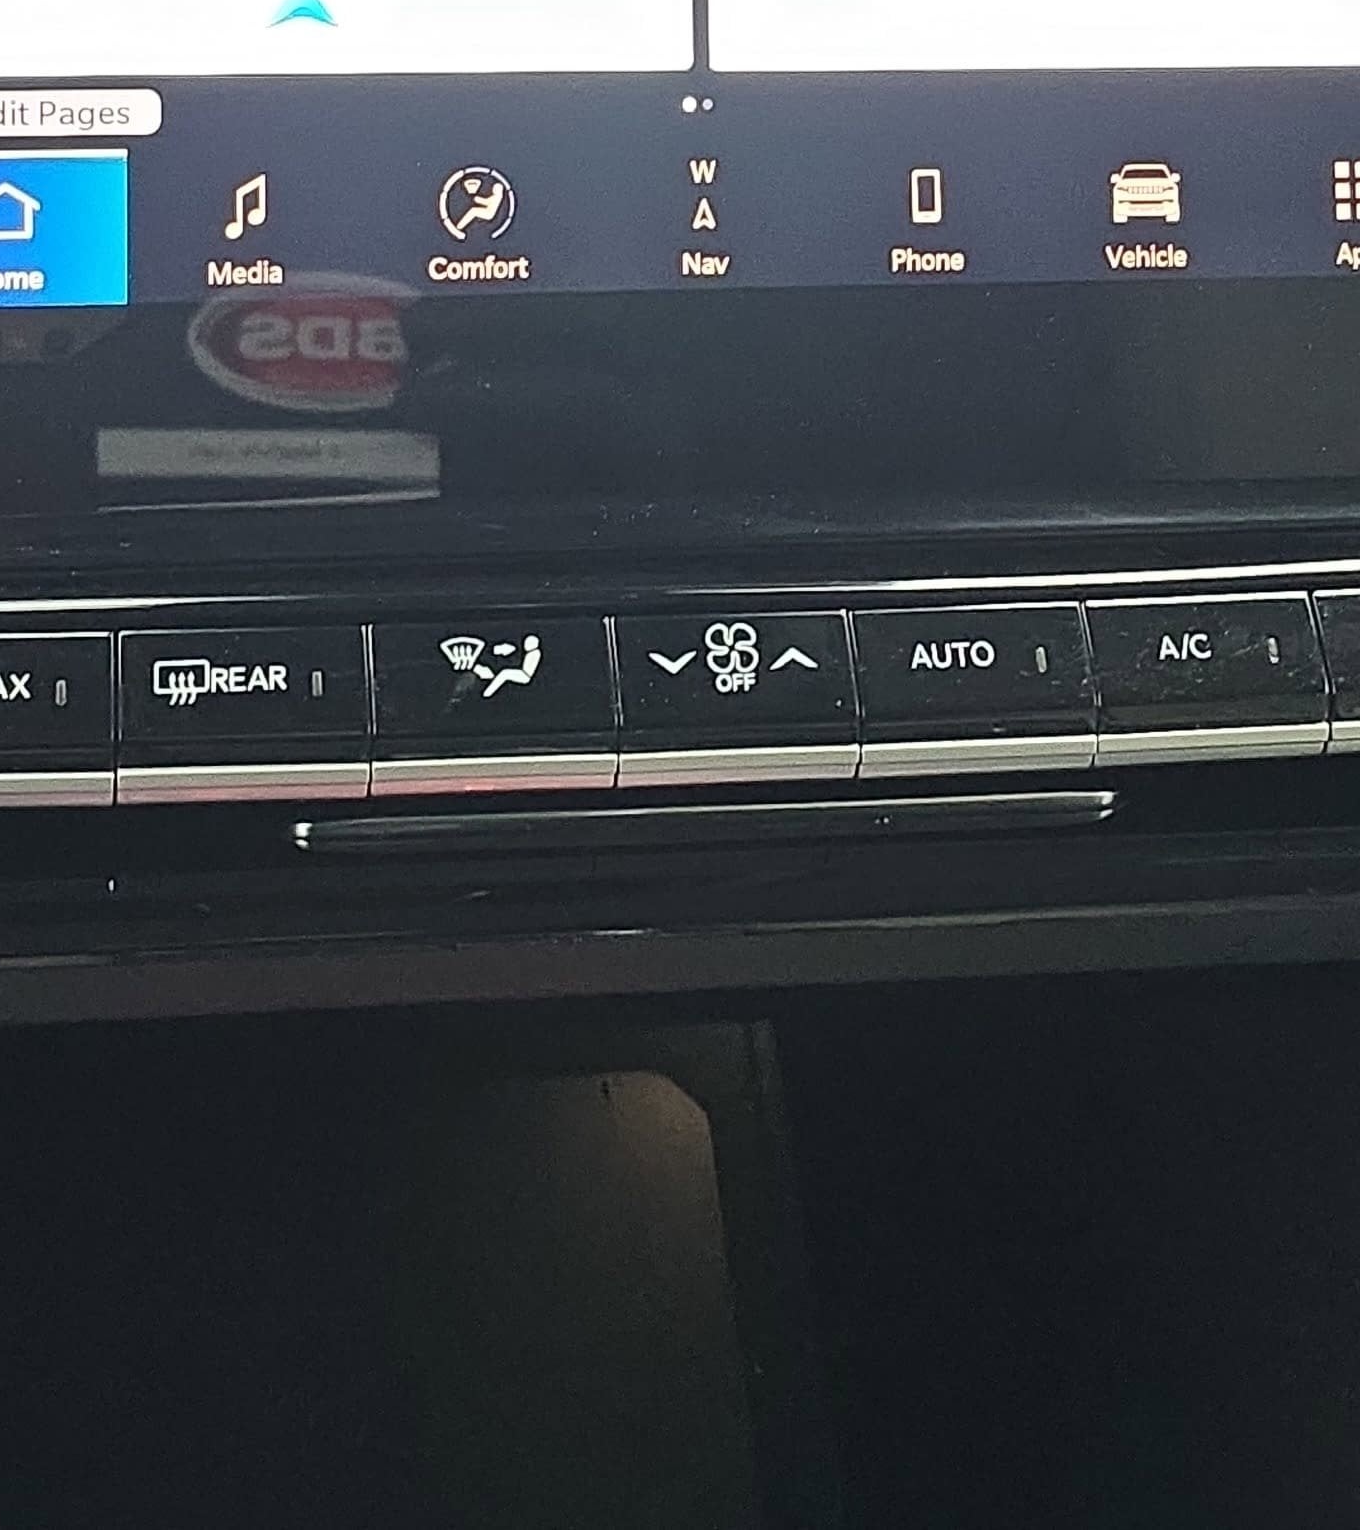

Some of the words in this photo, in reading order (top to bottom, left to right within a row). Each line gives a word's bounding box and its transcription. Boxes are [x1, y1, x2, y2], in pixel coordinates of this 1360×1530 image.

[40, 101, 131, 131] Pages
[427, 255, 530, 282] Comfort
[682, 250, 730, 277] Nav
[890, 247, 965, 273] Phone
[1104, 244, 1188, 271] Vehicle
[207, 260, 284, 286] Media
[911, 639, 996, 670] AUTO
[1158, 633, 1213, 662] A/C
[210, 665, 288, 694] REAR
[715, 673, 757, 695] OFF
